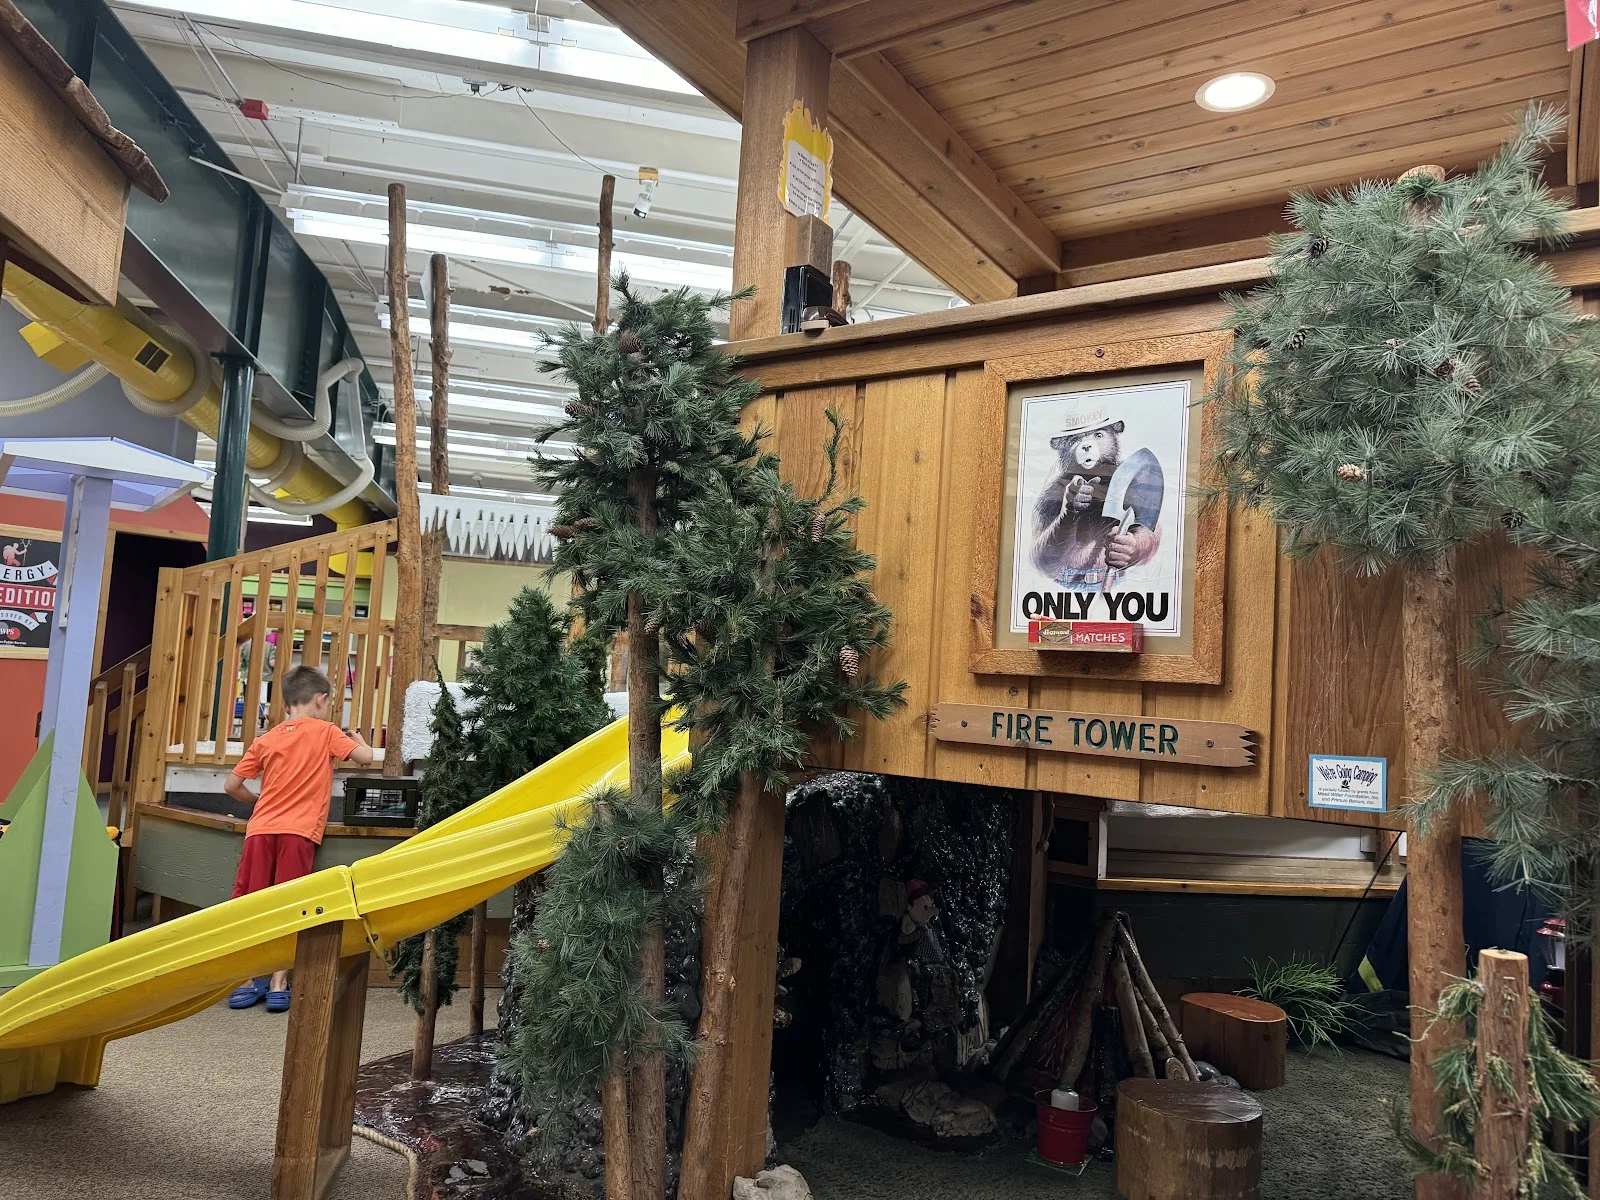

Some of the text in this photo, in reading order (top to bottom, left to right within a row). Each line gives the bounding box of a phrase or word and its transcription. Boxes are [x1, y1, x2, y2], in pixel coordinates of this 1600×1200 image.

[1065, 410, 1102, 428] SMOKEY
[1022, 591, 1169, 622] ONLY YOU
[1075, 632, 1126, 643] MATCHES
[991, 712, 1179, 756] FIRE TOWER
[1316, 764, 1378, 787] We're Going Camping
